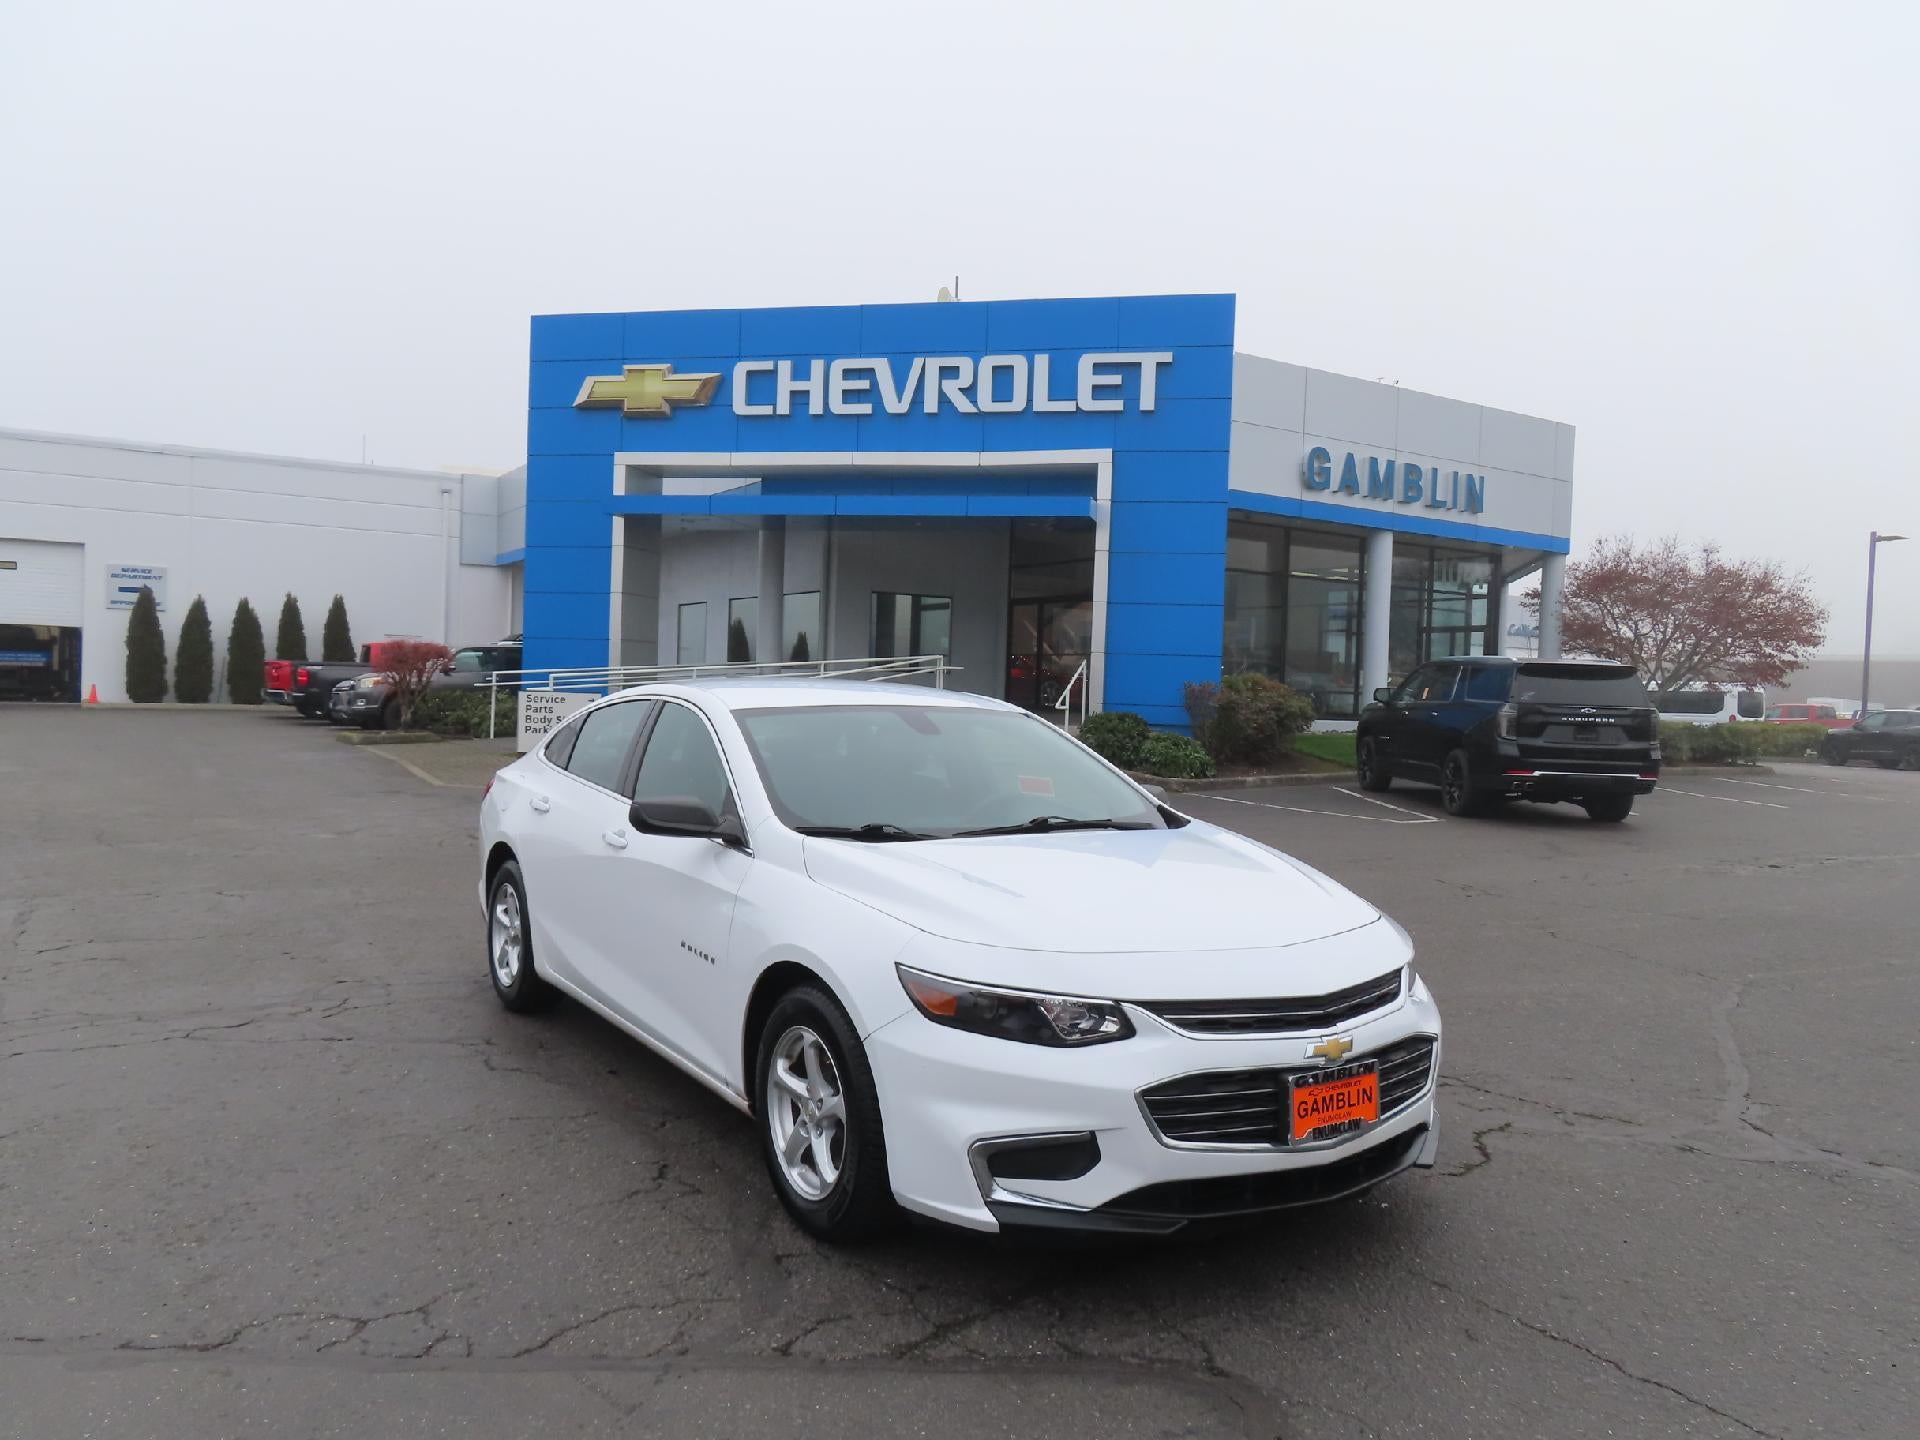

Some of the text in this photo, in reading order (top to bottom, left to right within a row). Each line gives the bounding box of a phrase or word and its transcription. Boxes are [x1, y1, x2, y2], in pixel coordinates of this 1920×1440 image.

[733, 352, 1173, 416] CHEVROLET
[1302, 446, 1485, 515] GAMBLIN
[526, 694, 566, 704] Service
[525, 704, 554, 714] Parts
[525, 714, 553, 726] Body
[524, 725, 552, 734] Park
[1324, 1080, 1361, 1092] CHEVROLET
[1297, 1086, 1373, 1119] GAMBLIN
[1317, 1110, 1352, 1125] ENUMCLAW
[1312, 1117, 1361, 1140] ENUMCLAW
